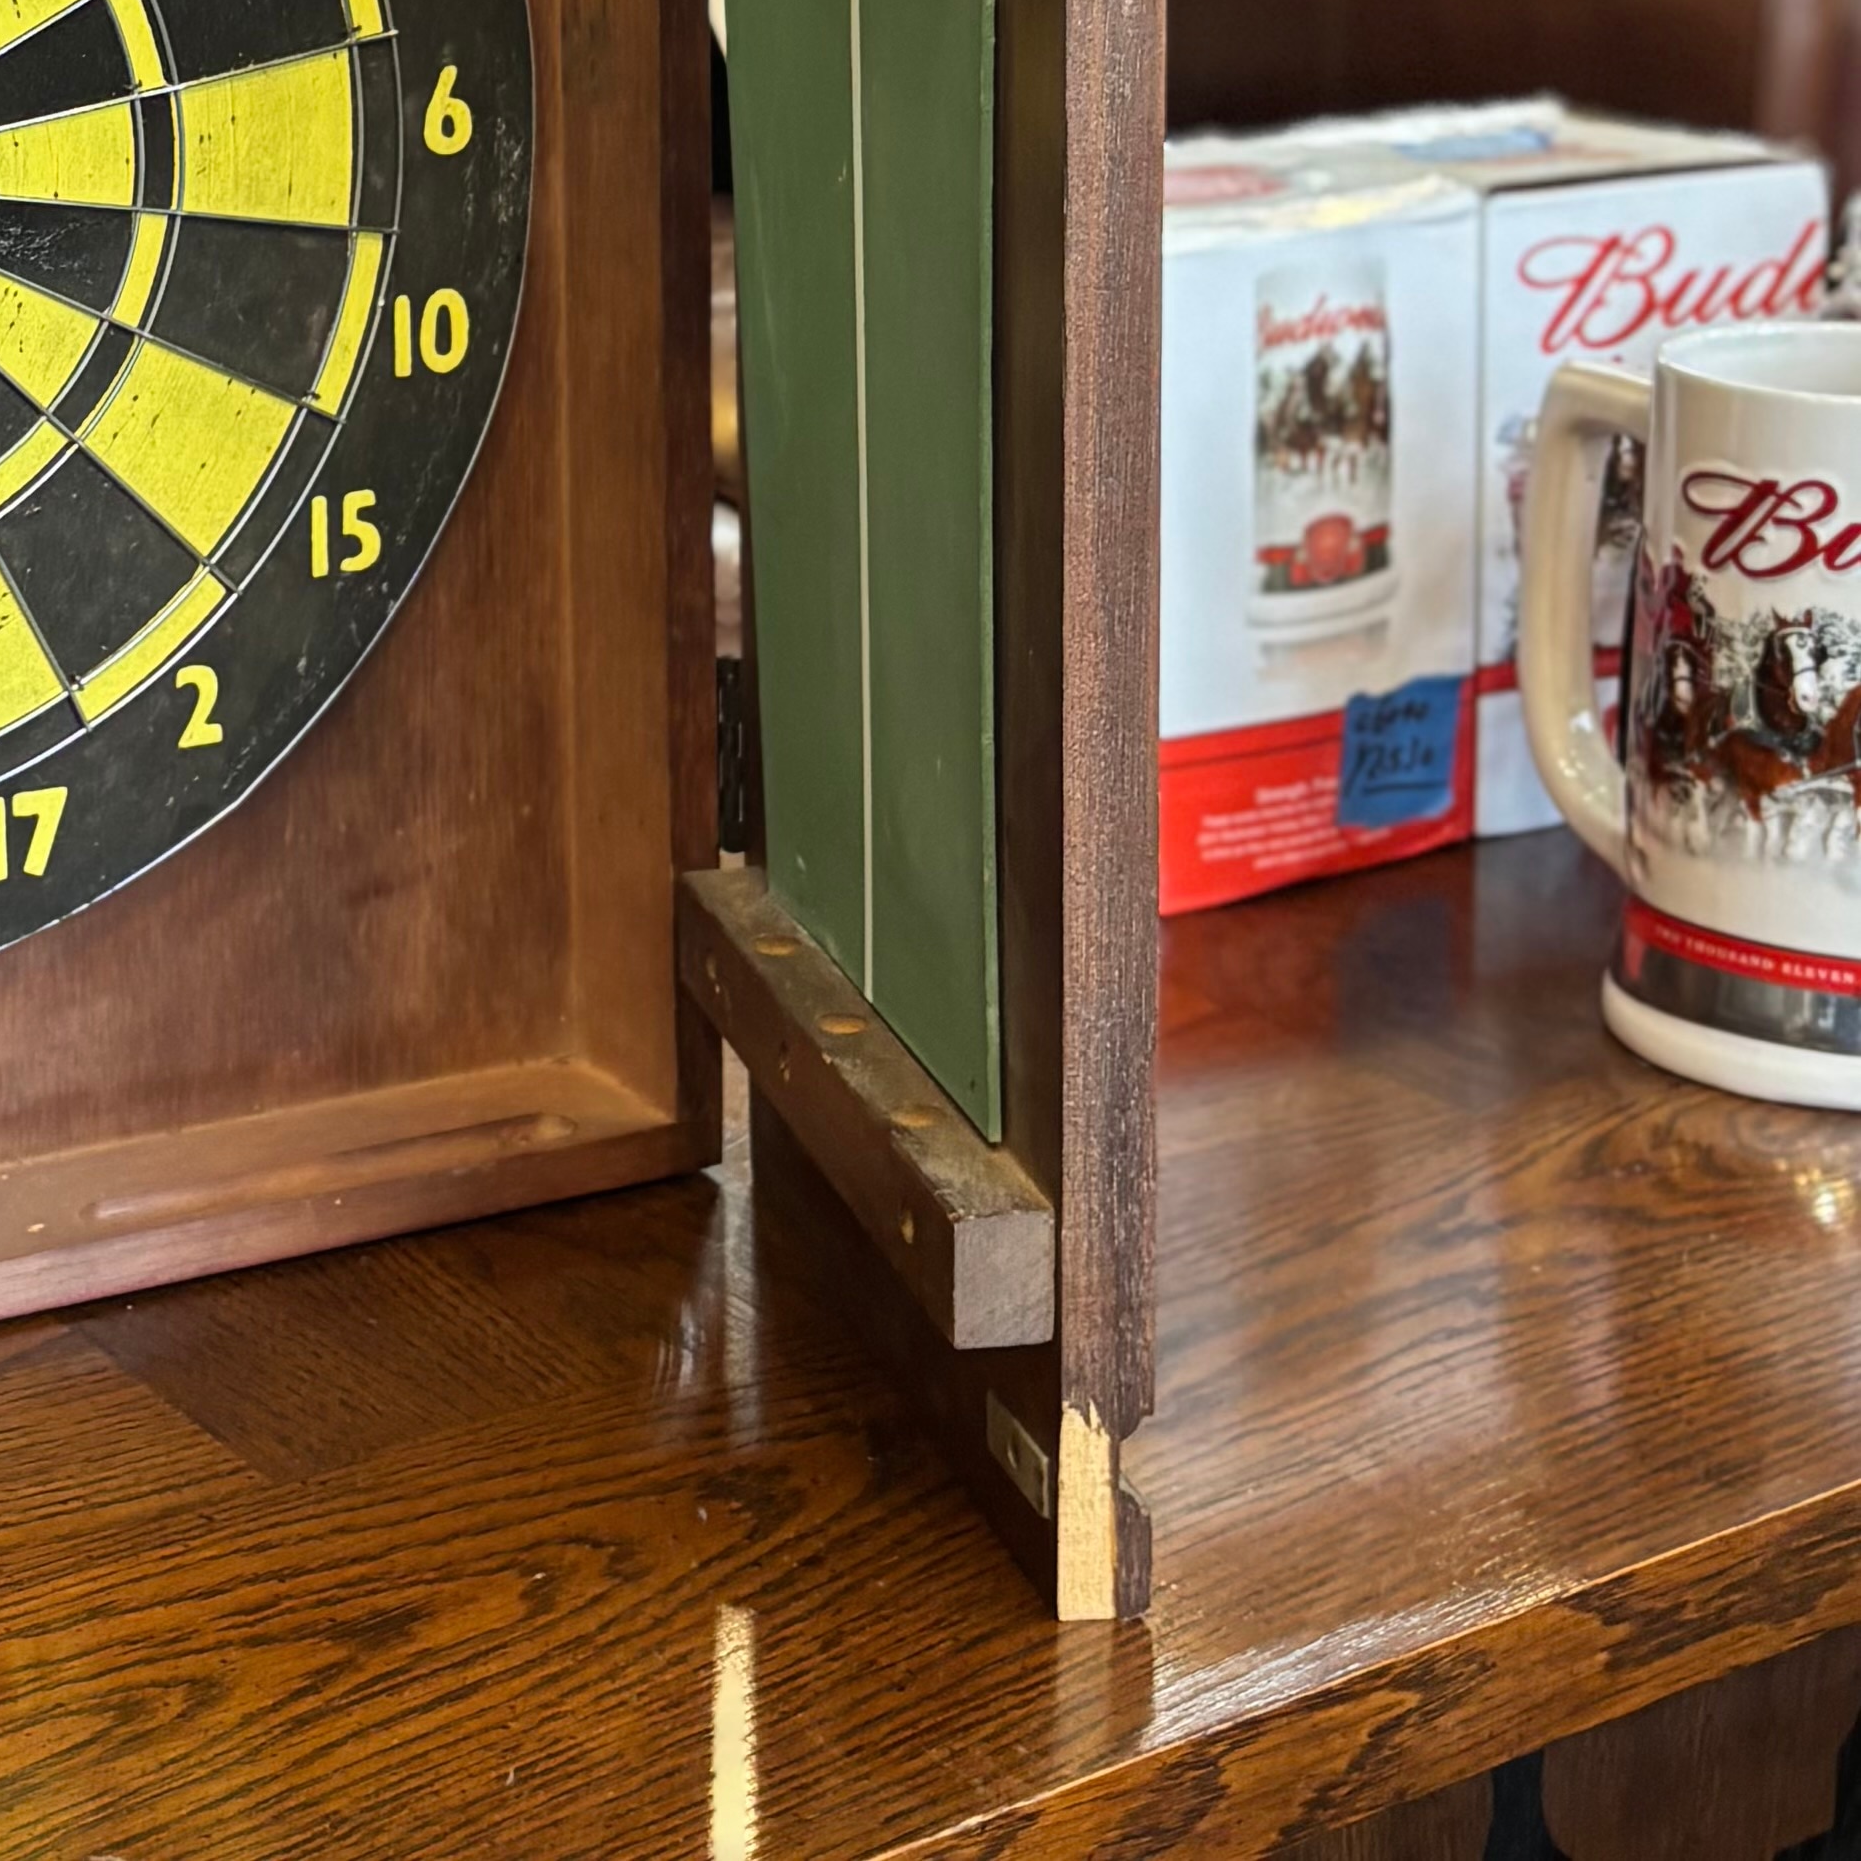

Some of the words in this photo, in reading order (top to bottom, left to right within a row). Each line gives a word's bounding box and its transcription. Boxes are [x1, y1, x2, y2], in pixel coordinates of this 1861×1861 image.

[423, 65, 473, 156] 6
[393, 288, 470, 379] 10
[310, 489, 382, 578] 15
[177, 665, 224, 749] 2
[1780, 960, 1857, 986] ELEVEN
